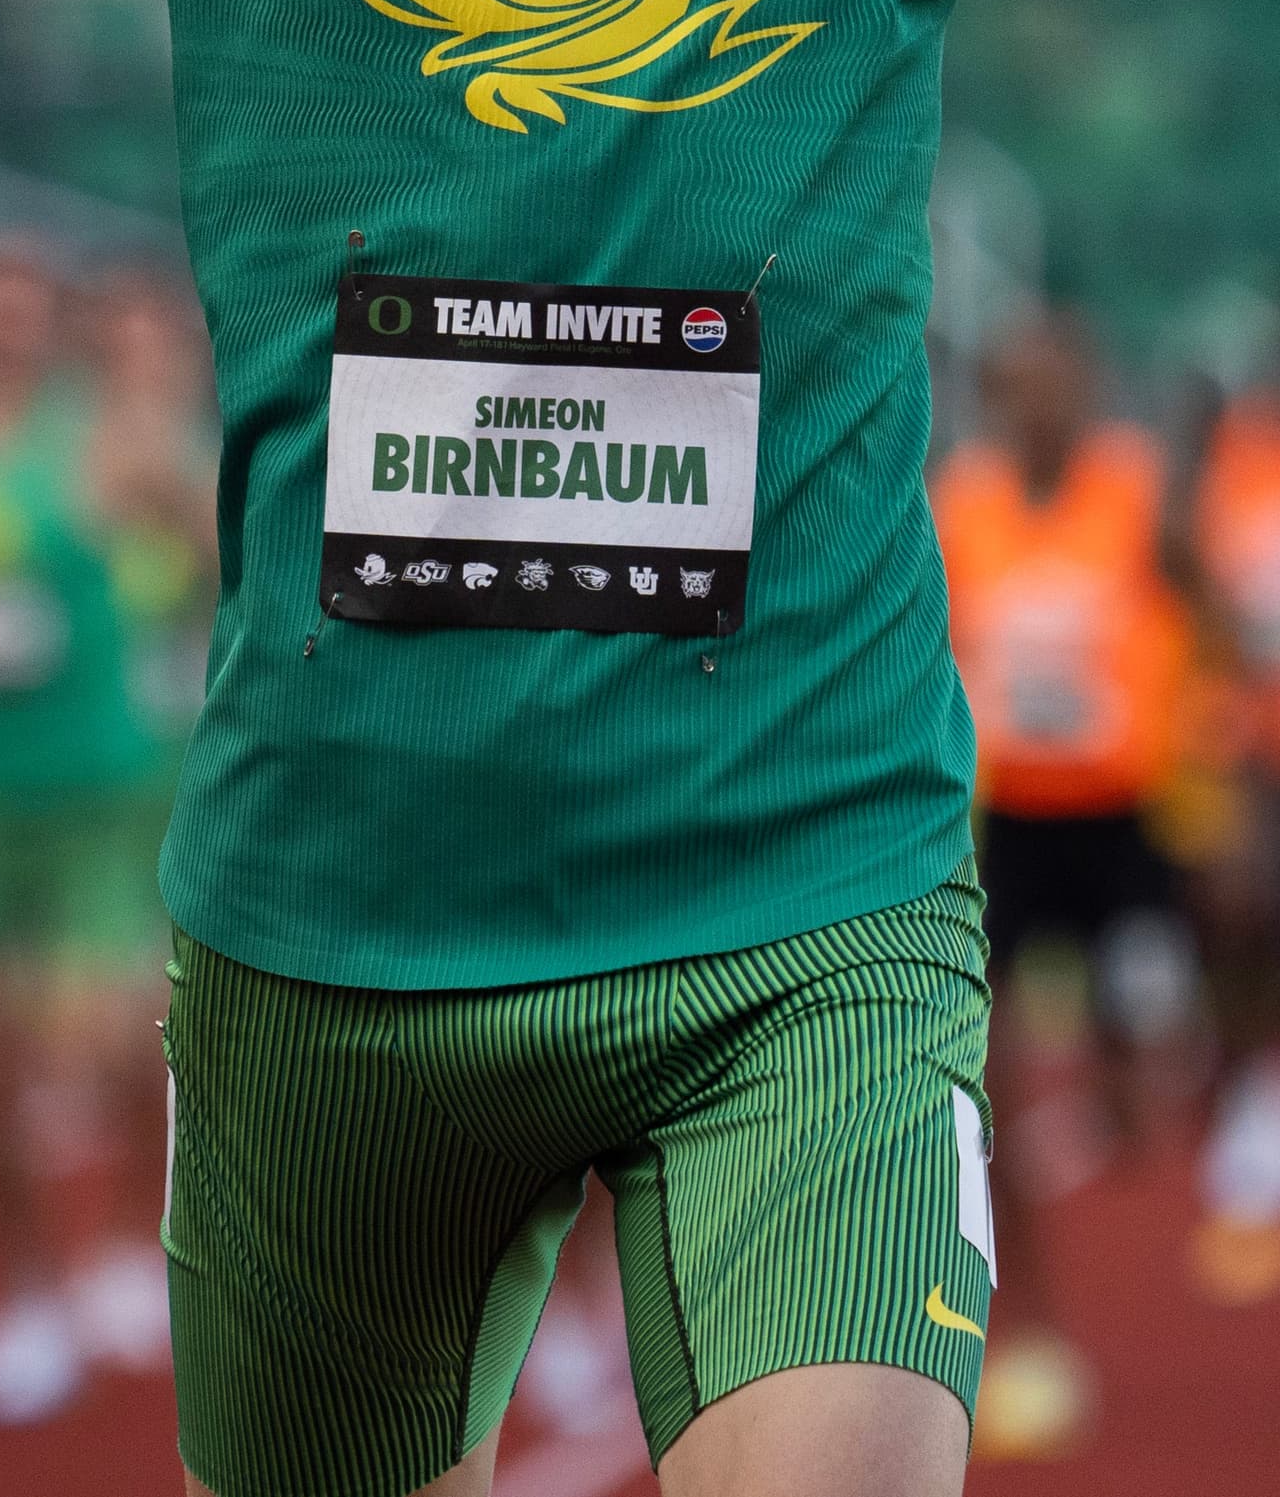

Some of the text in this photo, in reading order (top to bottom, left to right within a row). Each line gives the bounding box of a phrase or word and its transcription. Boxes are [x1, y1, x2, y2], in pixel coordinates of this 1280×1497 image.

[368, 295, 412, 335] O
[433, 297, 662, 344] TEAM INVITE
[684, 324, 724, 336] PEPSI
[475, 395, 605, 432] SIMEON
[372, 432, 709, 506] BIRNBAUM
[404, 561, 449, 584] OSU
